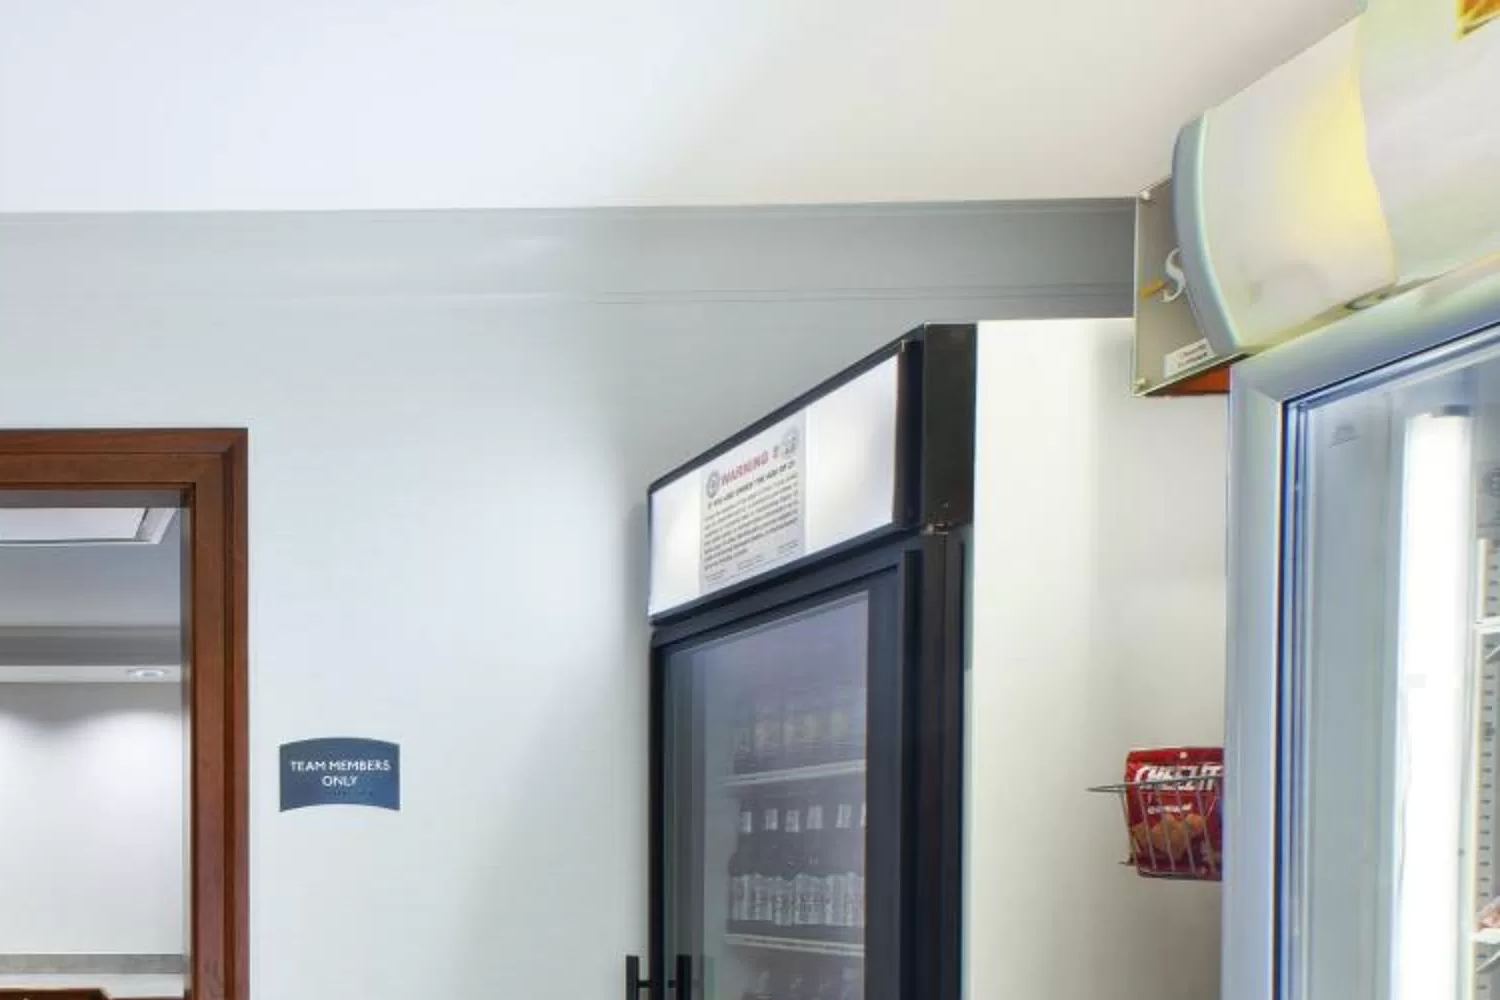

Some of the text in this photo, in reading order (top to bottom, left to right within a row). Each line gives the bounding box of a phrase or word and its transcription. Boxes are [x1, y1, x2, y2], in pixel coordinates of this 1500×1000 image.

[720, 450, 769, 487] WARNING
[290, 759, 391, 772] TEAM MEMBERS
[321, 774, 358, 788] ONLY
